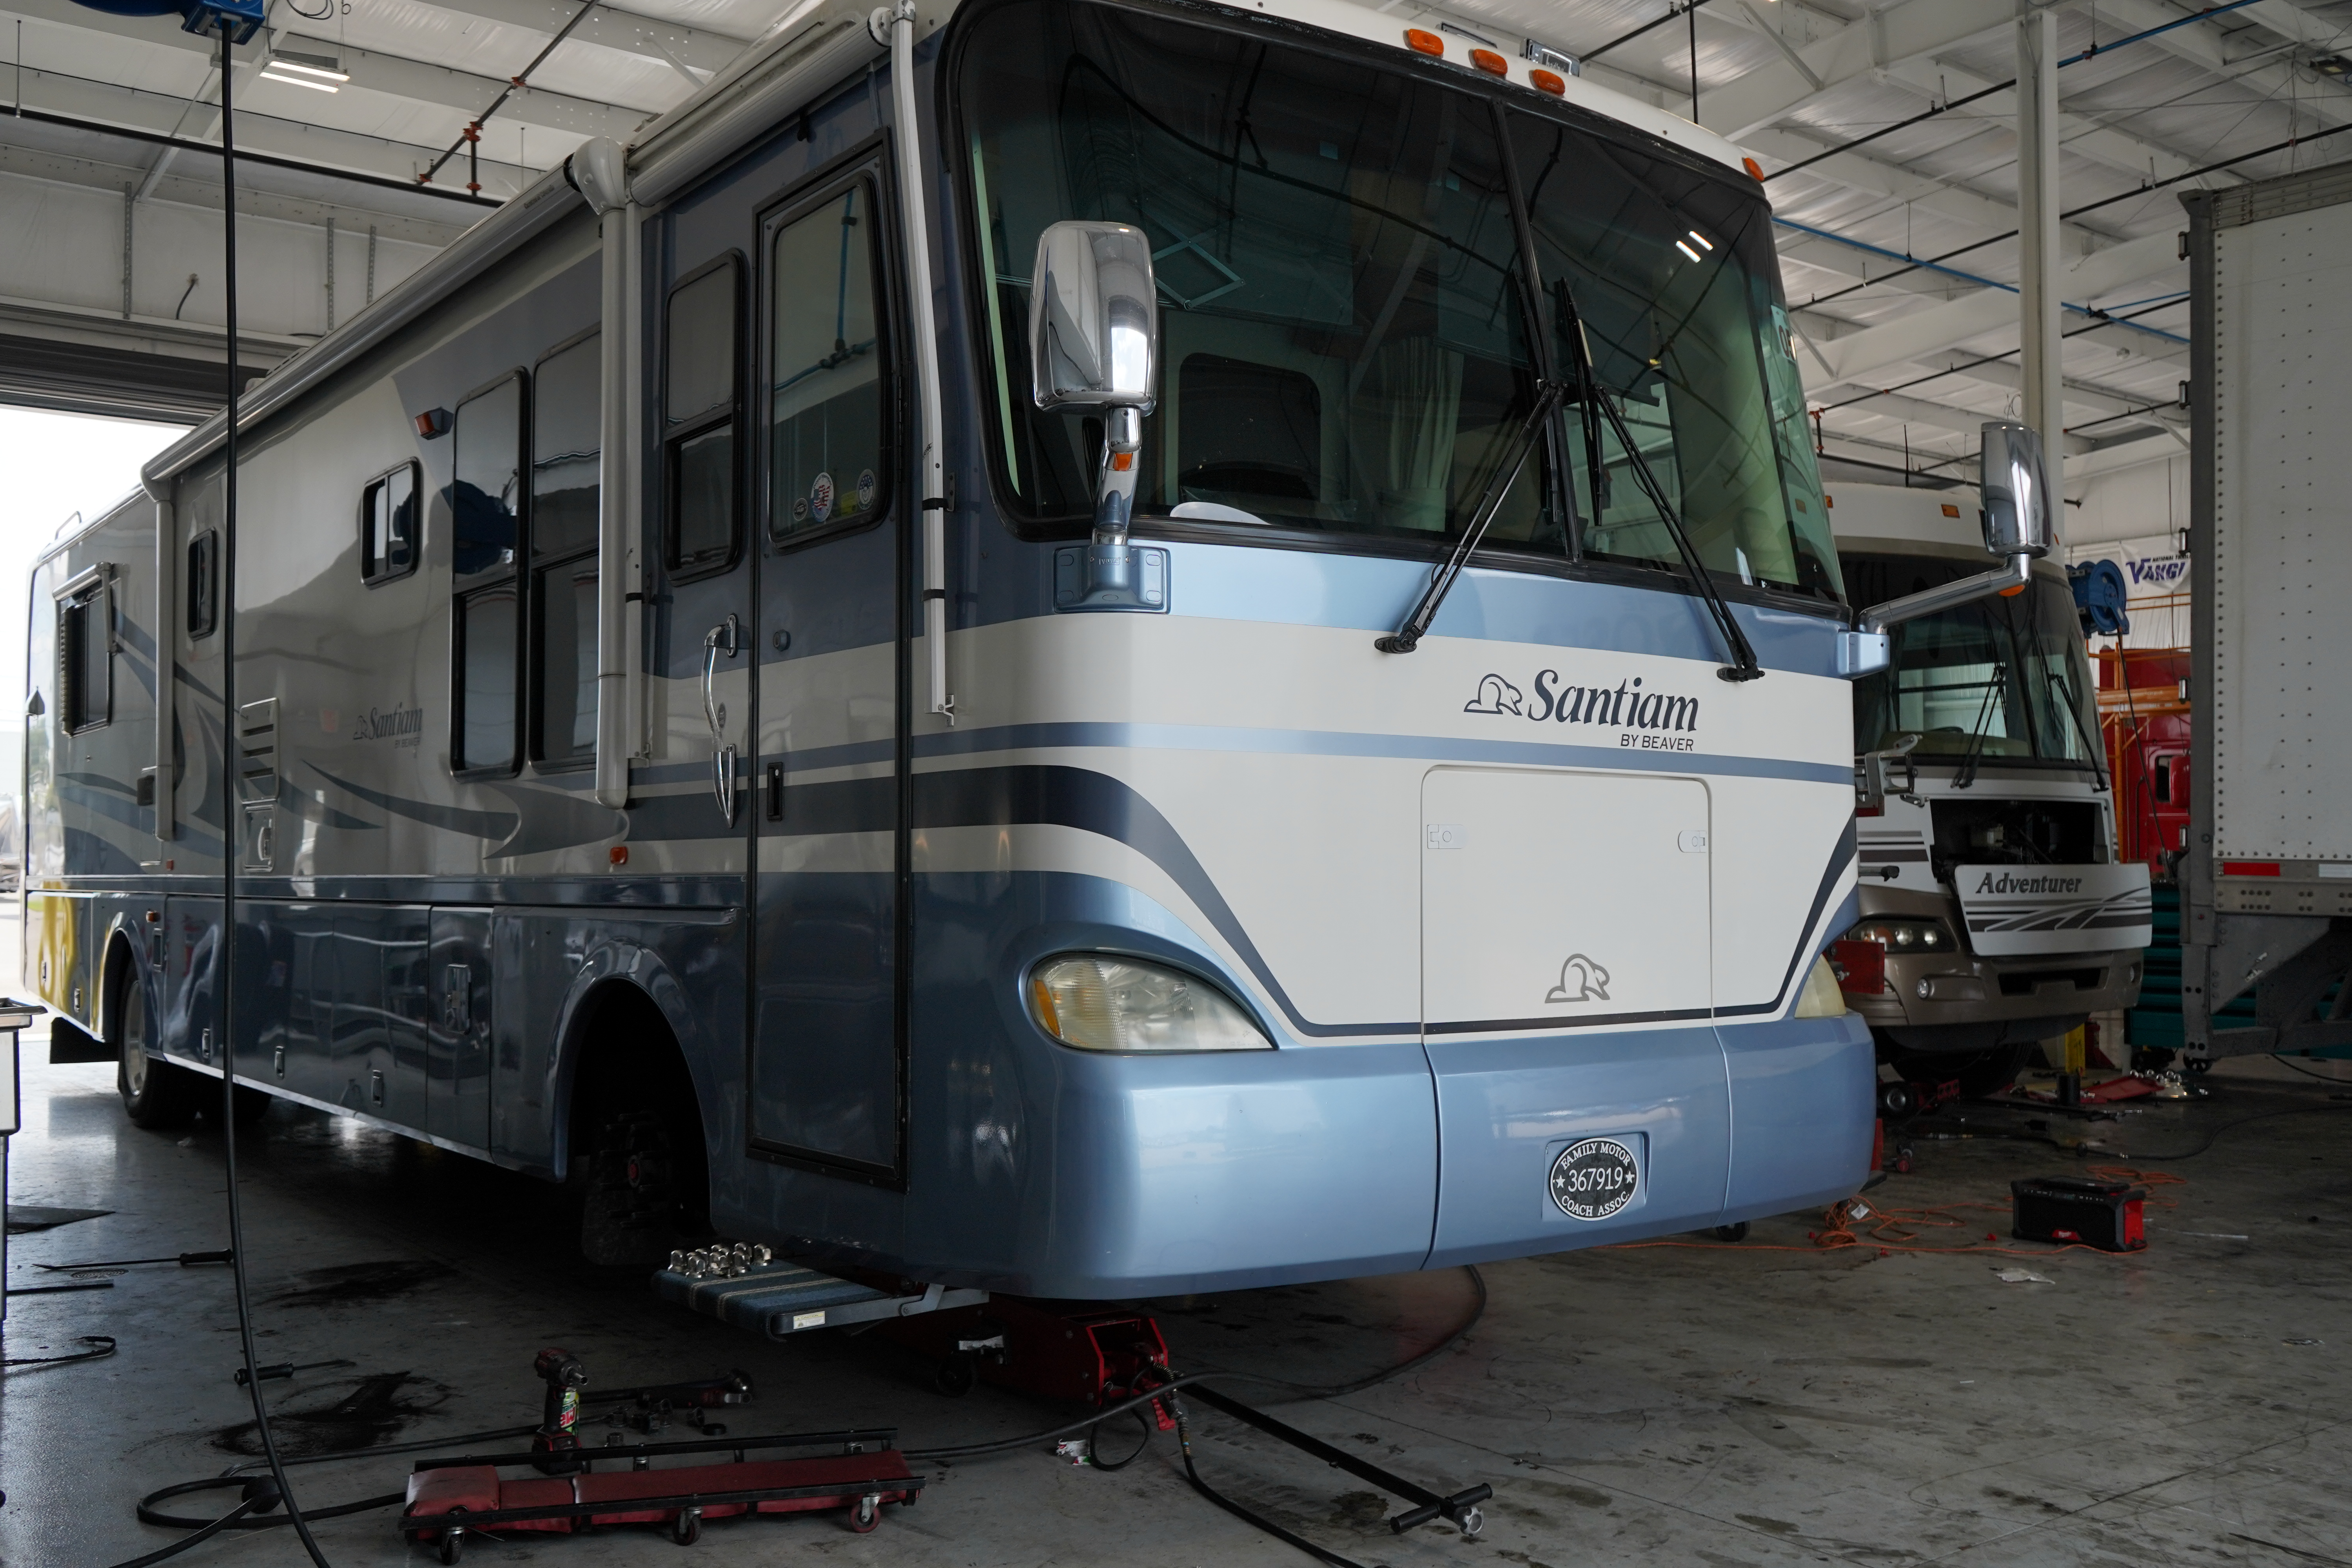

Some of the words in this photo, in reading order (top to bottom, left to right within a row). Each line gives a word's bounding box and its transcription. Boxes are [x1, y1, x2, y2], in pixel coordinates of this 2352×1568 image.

[1528, 669, 1699, 732] Santiam
[368, 702, 423, 740] Santiam
[1620, 733, 1639, 747] BY
[1642, 735, 1694, 751] BEAVER
[1975, 871, 2082, 894] Adventurer
[1560, 1142, 1598, 1170] FAMILY
[1600, 1142, 1631, 1167] MOTOR
[1568, 1167, 1623, 1192] 367919
[1561, 1195, 1593, 1217] COACH
[1597, 1191, 1630, 1216] ASSOC.
